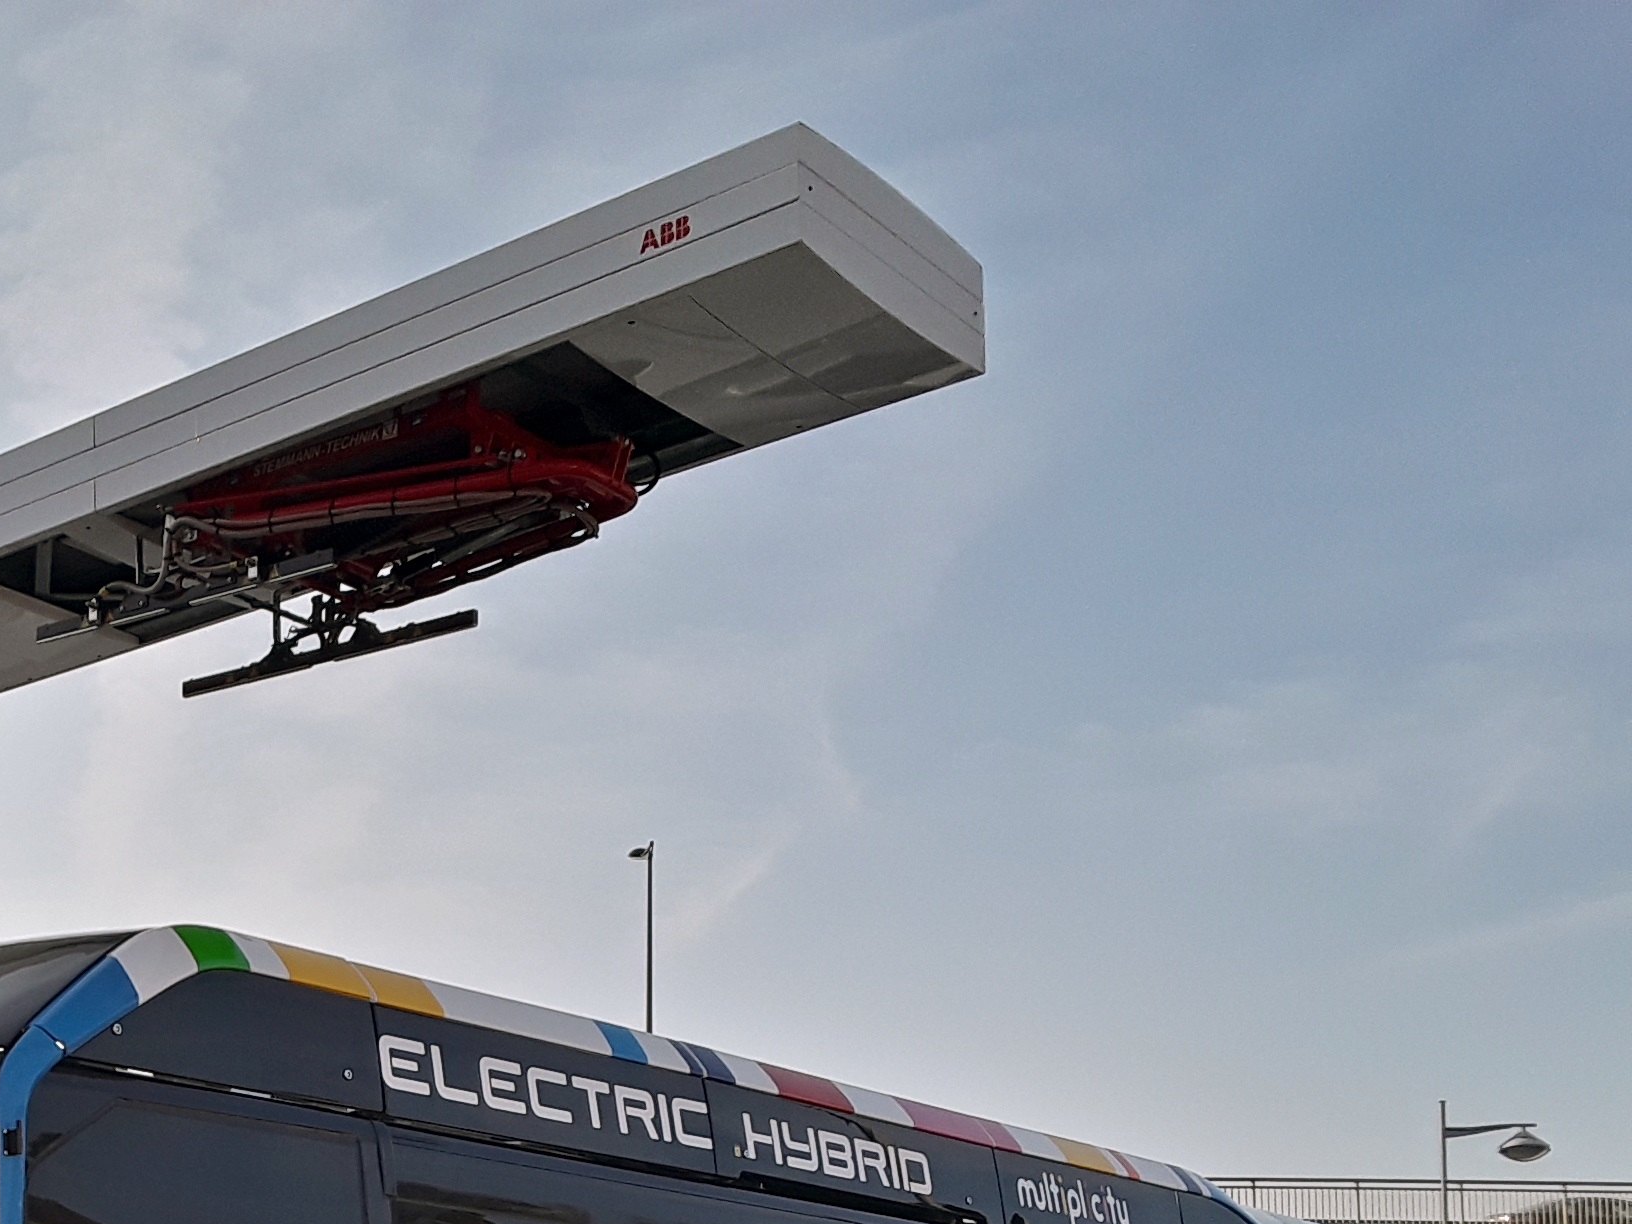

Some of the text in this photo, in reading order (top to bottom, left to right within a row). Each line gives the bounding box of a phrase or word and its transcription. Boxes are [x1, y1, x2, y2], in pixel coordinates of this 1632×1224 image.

[640, 215, 691, 255] ABB
[253, 426, 381, 477] STEMMANN-TECHNIK
[378, 1034, 932, 1196] ELECTRIC HYBRID
